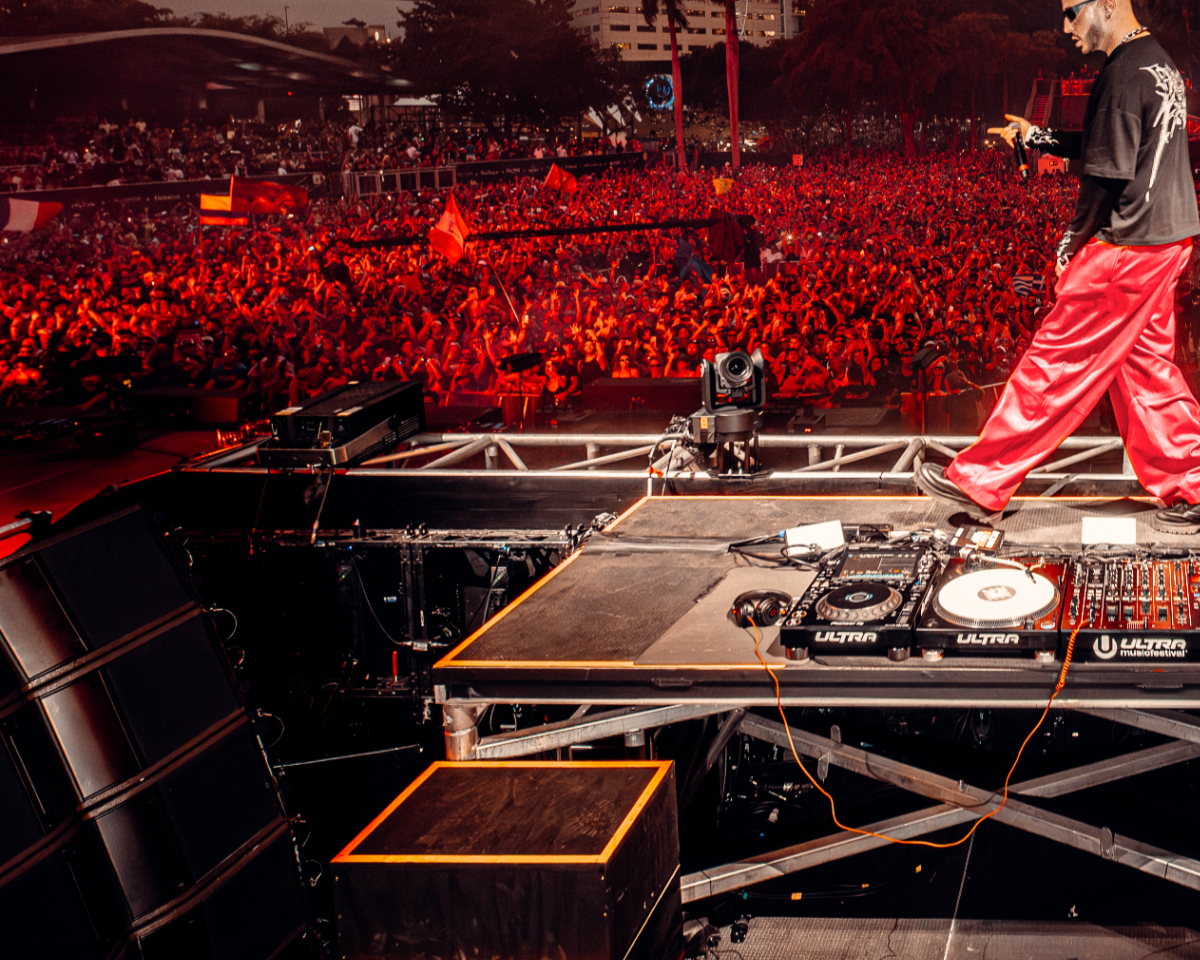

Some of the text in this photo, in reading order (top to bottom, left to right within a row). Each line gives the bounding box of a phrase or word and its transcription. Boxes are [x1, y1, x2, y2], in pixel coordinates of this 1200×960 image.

[814, 631, 877, 644] ULTRA
[957, 633, 1020, 646] ULTRA
[1120, 637, 1187, 651] ULTRA
